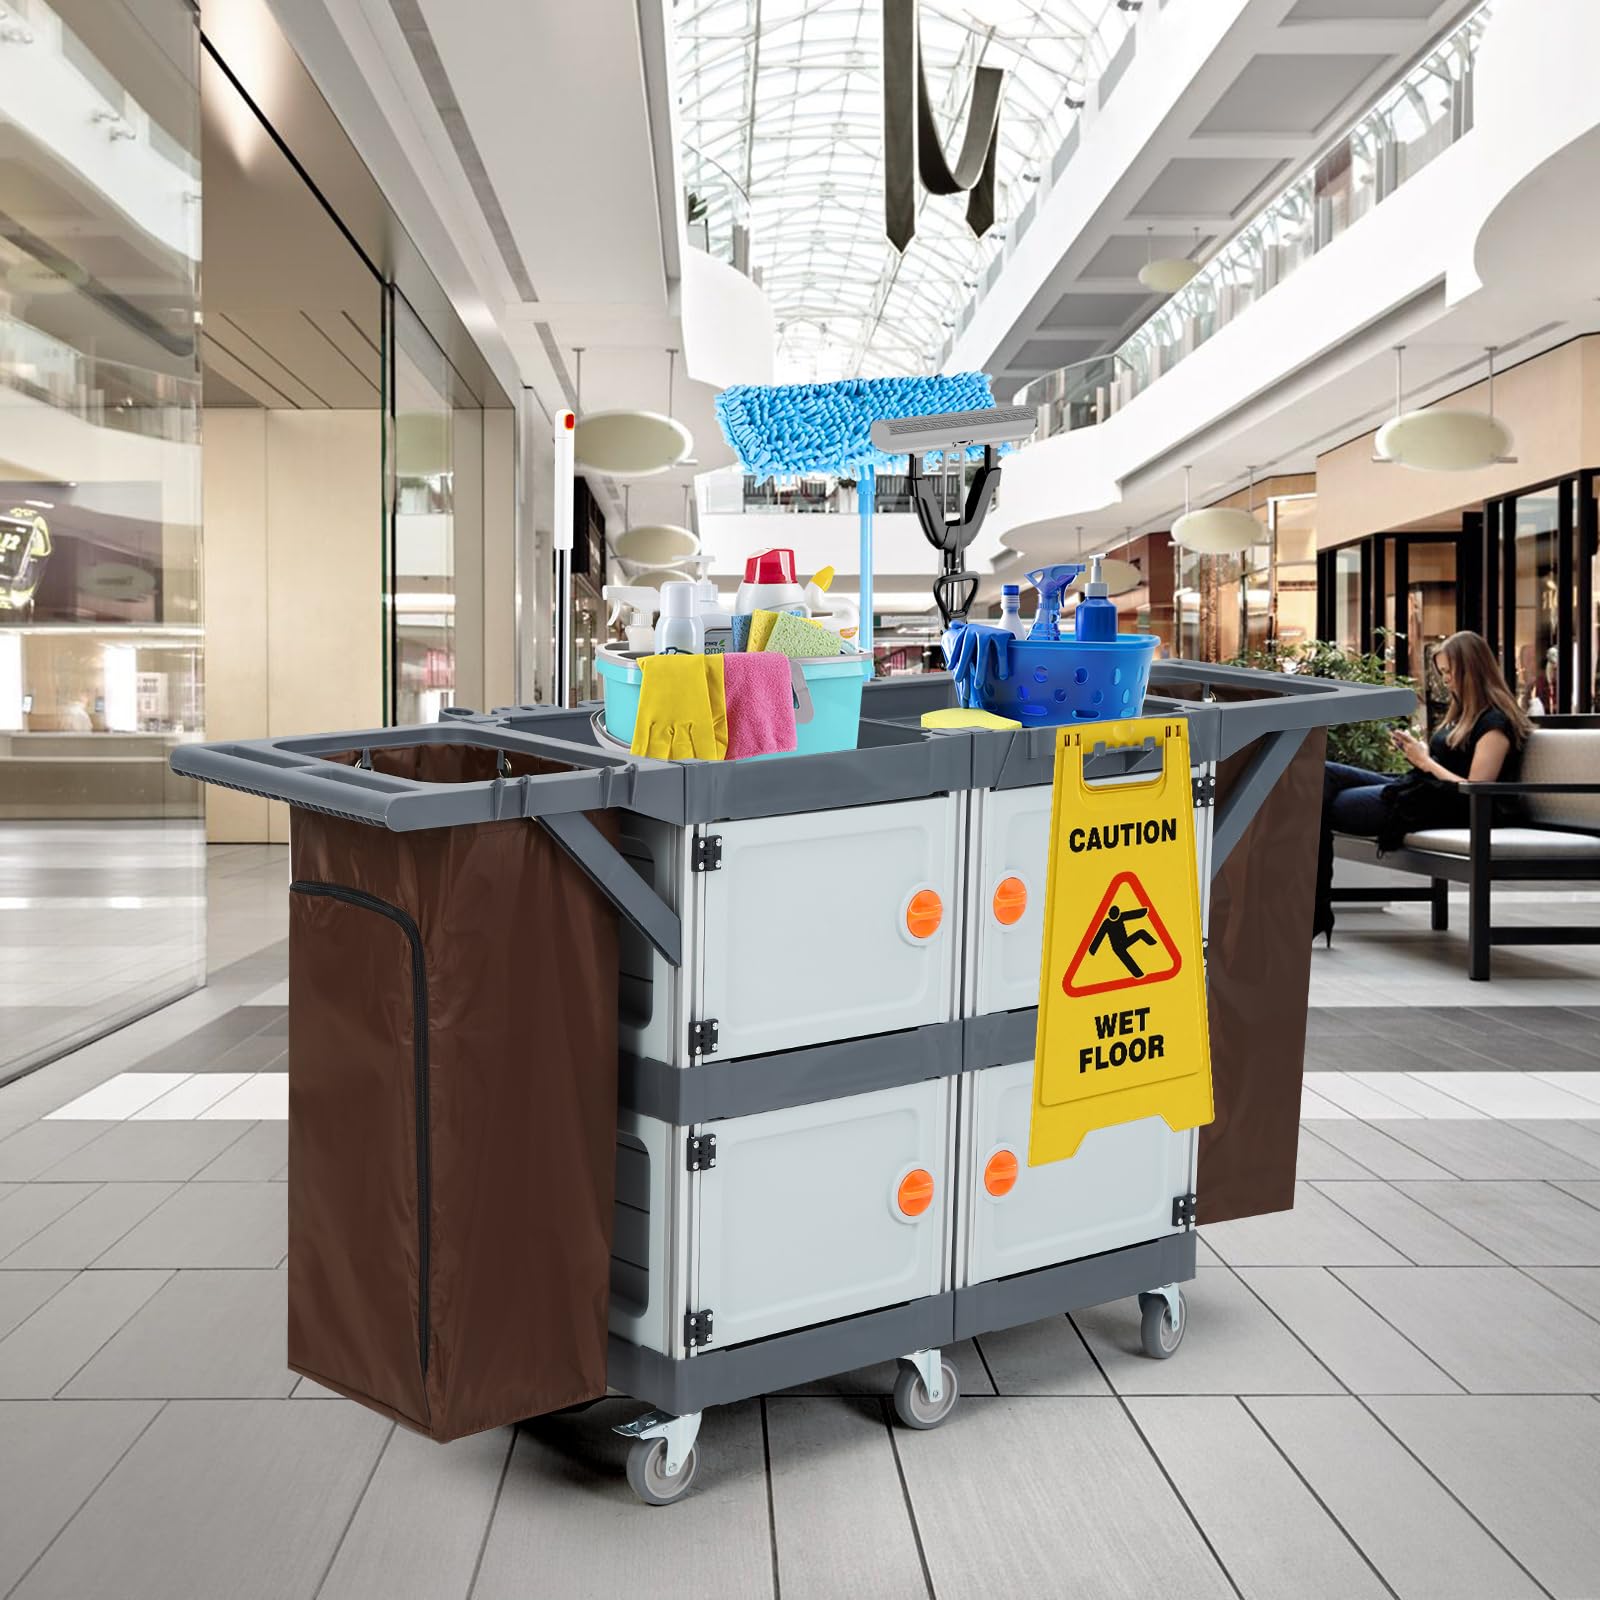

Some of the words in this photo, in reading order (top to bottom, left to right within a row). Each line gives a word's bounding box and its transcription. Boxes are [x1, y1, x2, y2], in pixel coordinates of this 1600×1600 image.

[704, 647, 725, 655] ome
[1069, 818, 1177, 853] CAUTION
[1094, 1006, 1151, 1040] WET
[1079, 1034, 1165, 1074] FLOOR
